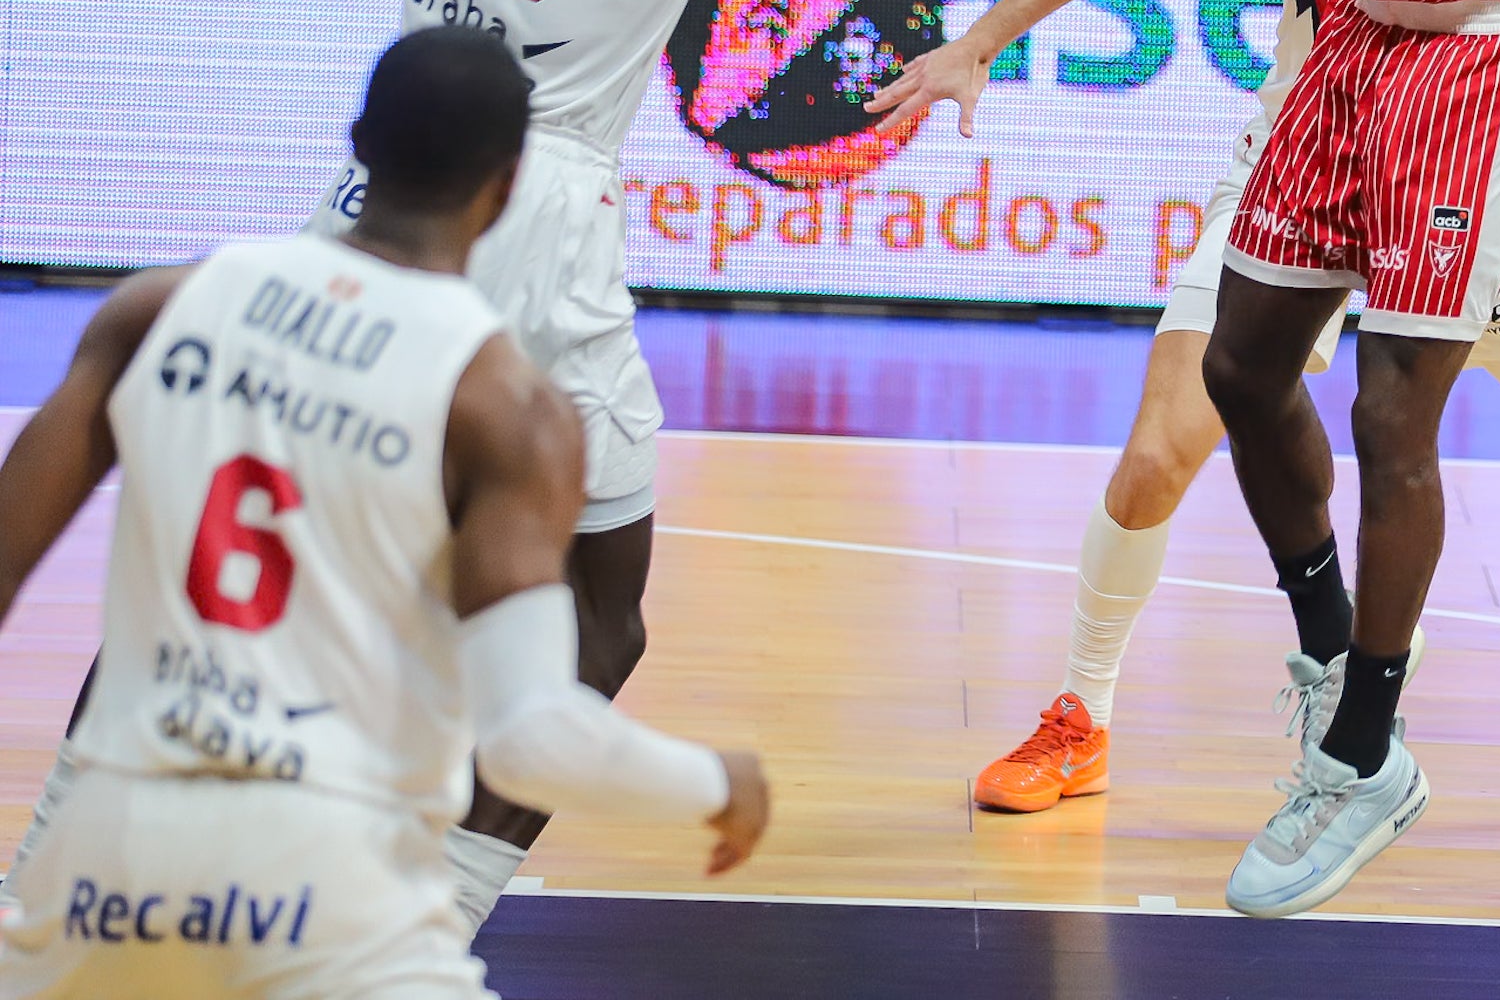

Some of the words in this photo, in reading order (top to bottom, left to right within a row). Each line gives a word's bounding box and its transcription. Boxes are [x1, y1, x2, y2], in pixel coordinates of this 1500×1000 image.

[1435, 214, 1462, 229] acb
[243, 273, 396, 373] DIALLO
[224, 368, 411, 468] AMUTIO
[185, 453, 305, 633] 6
[64, 875, 316, 946] Recalvi
